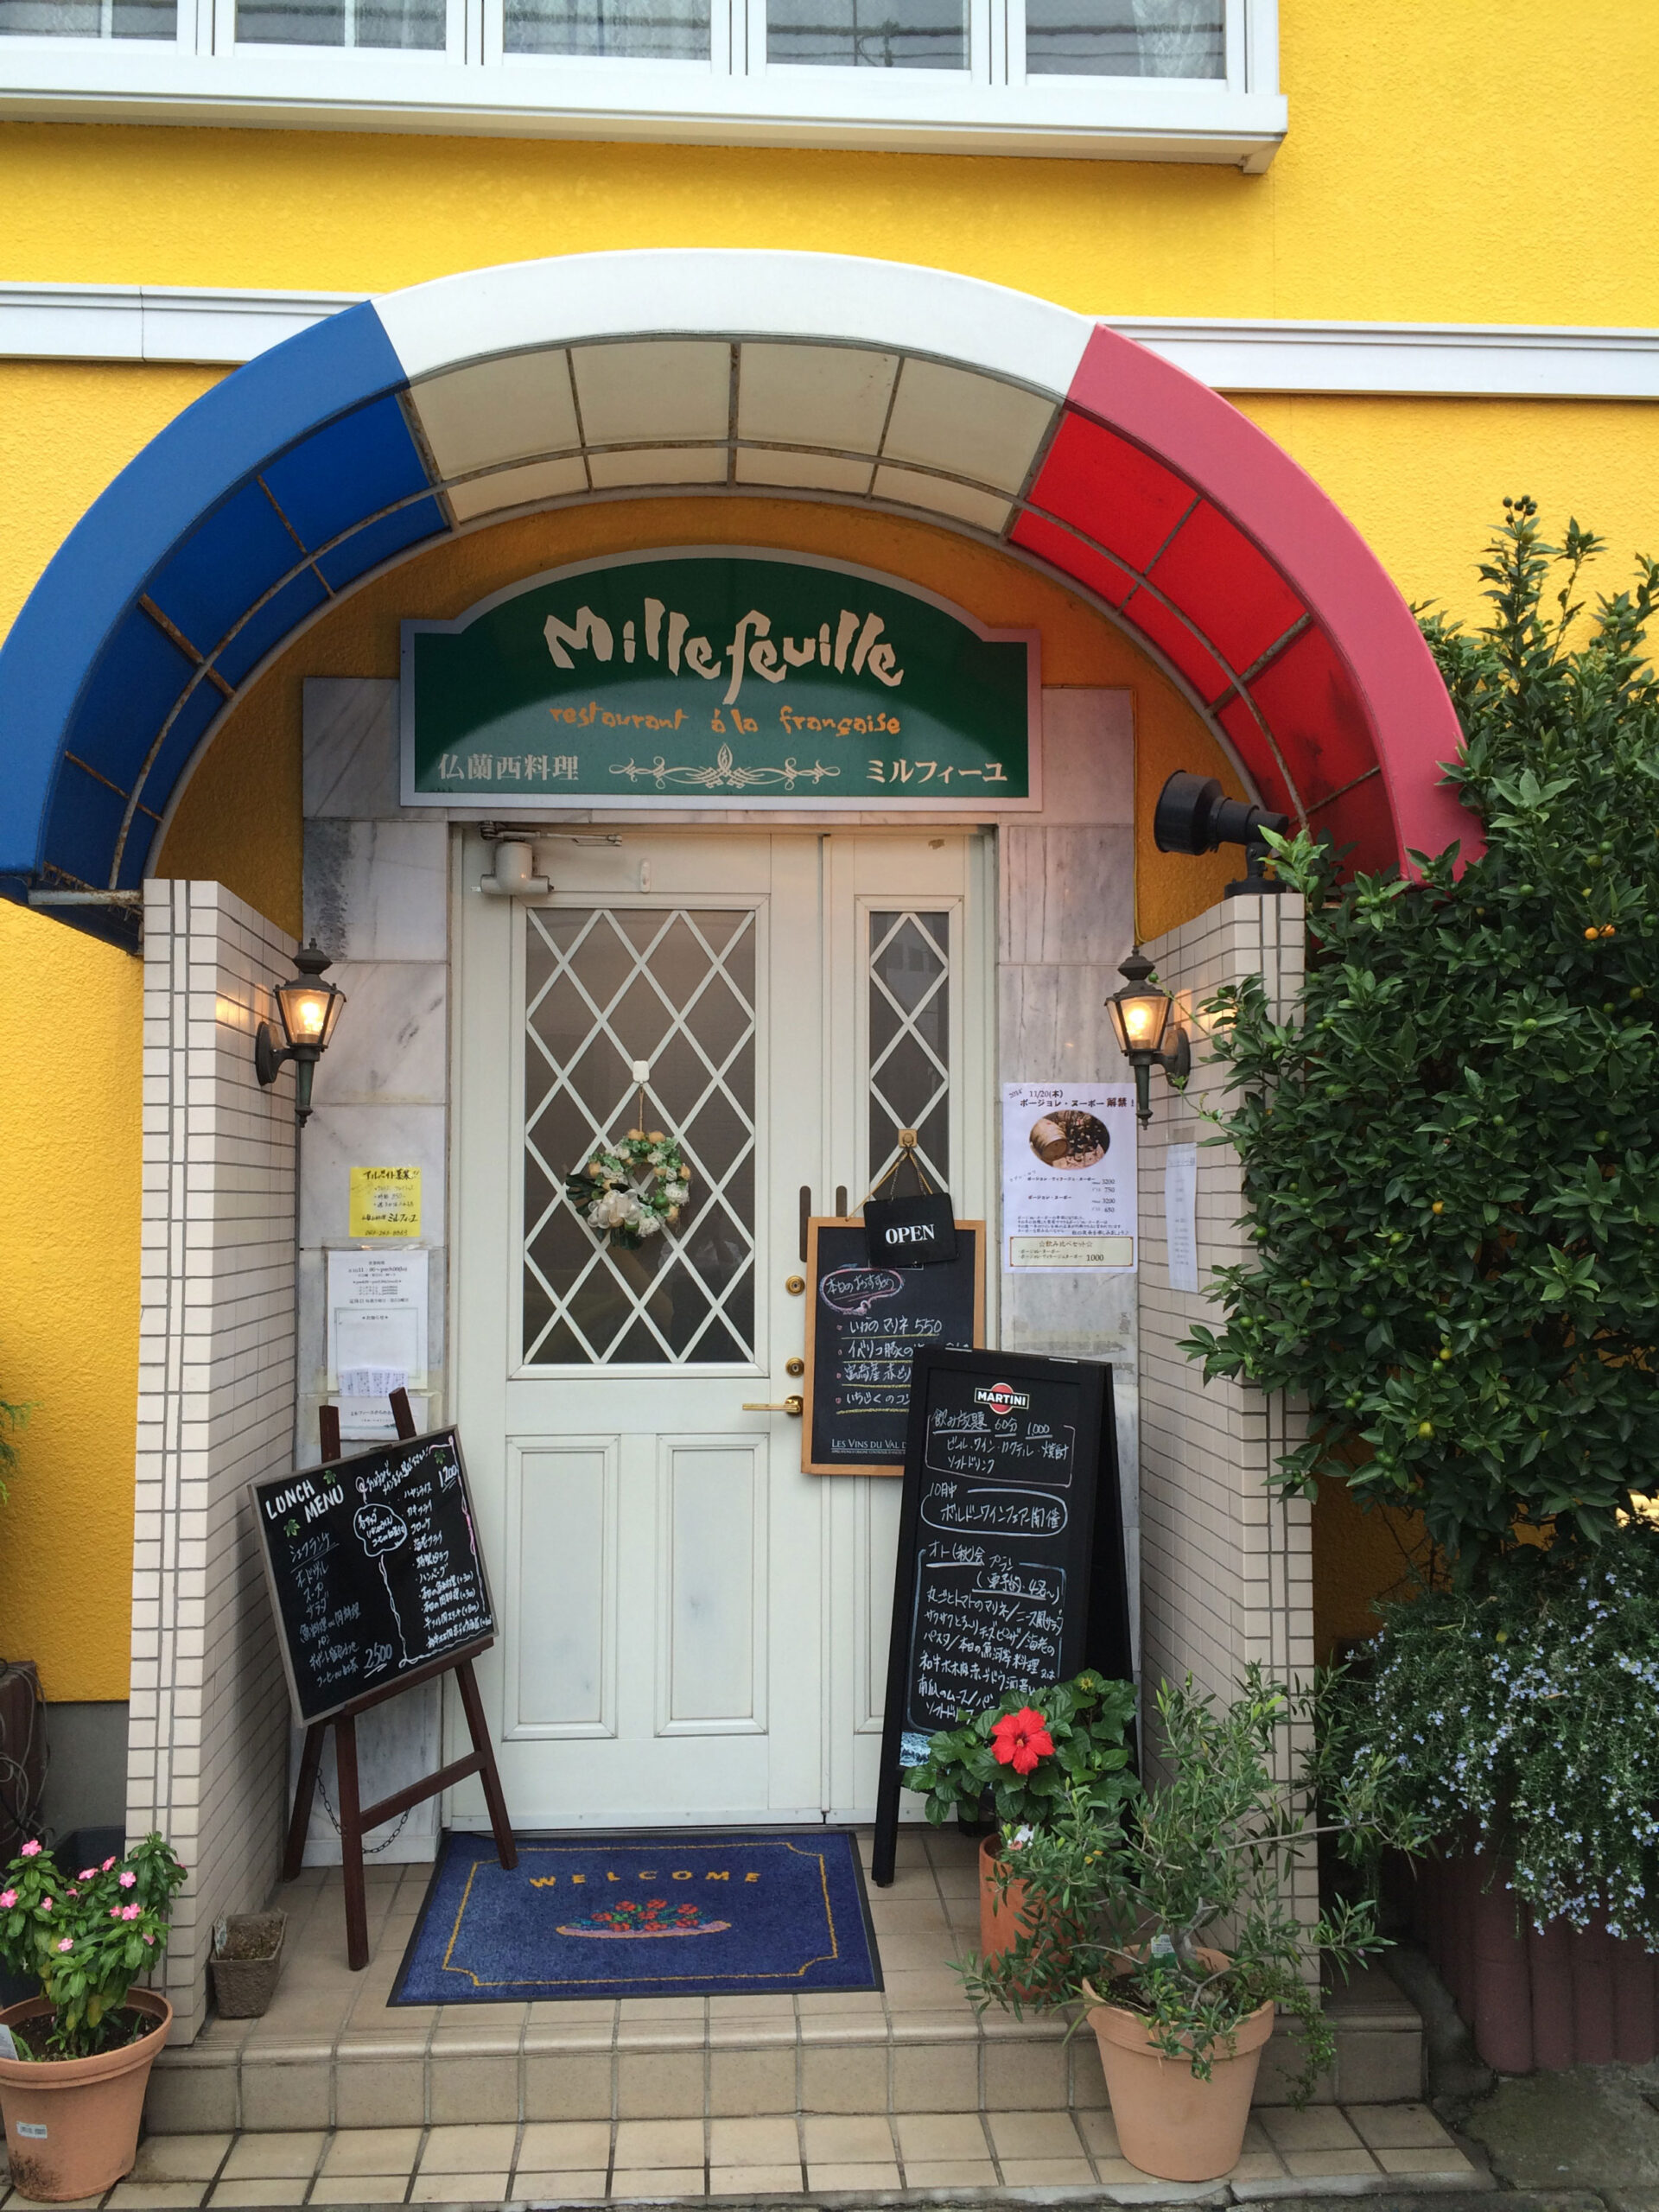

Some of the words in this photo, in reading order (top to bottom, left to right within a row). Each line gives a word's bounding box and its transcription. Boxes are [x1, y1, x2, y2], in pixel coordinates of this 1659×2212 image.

[543, 598, 904, 704] Millefeuille
[550, 702, 689, 731] restaurant
[730, 708, 759, 734] la
[779, 705, 901, 737] française
[437, 753, 580, 782] 仏蘭西料理
[865, 759, 1008, 785] ミルフィーユ
[885, 1224, 936, 1245] OPEN
[915, 1318, 943, 1335] 550
[977, 1391, 1027, 1407] MARTINI
[995, 1418, 1018, 1432] 60分
[437, 1465, 458, 1488] 1200
[265, 1478, 315, 1520] LUNCH
[304, 1484, 345, 1523] MENU
[364, 1642, 393, 1669] 2500
[530, 1870, 762, 1889] WELCOME
